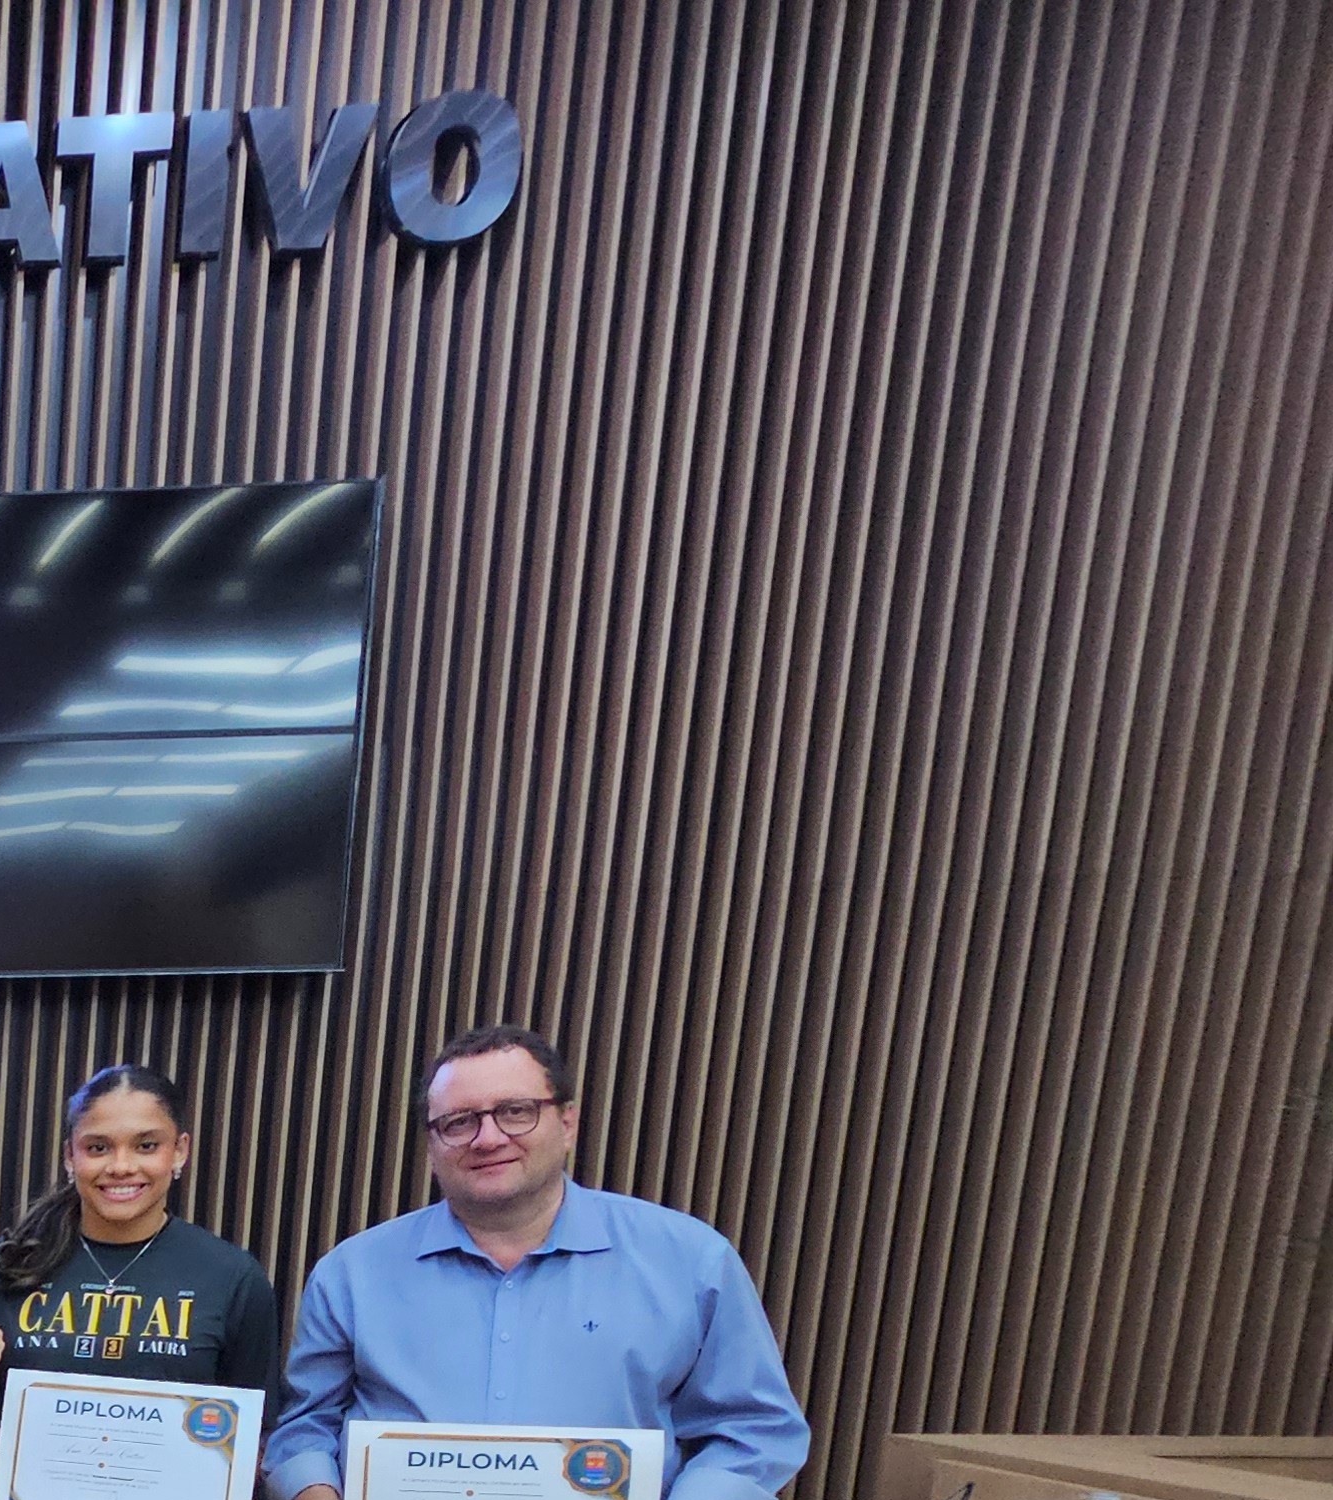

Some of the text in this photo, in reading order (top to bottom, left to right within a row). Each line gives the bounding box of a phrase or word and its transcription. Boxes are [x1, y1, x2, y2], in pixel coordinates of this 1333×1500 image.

[18, 1290, 195, 1340] CATTAI
[14, 1335, 188, 1357] ANA 2 3 LAURA
[54, 1398, 163, 1424] DIPLOMA
[406, 1450, 540, 1472] DIPLOMA
